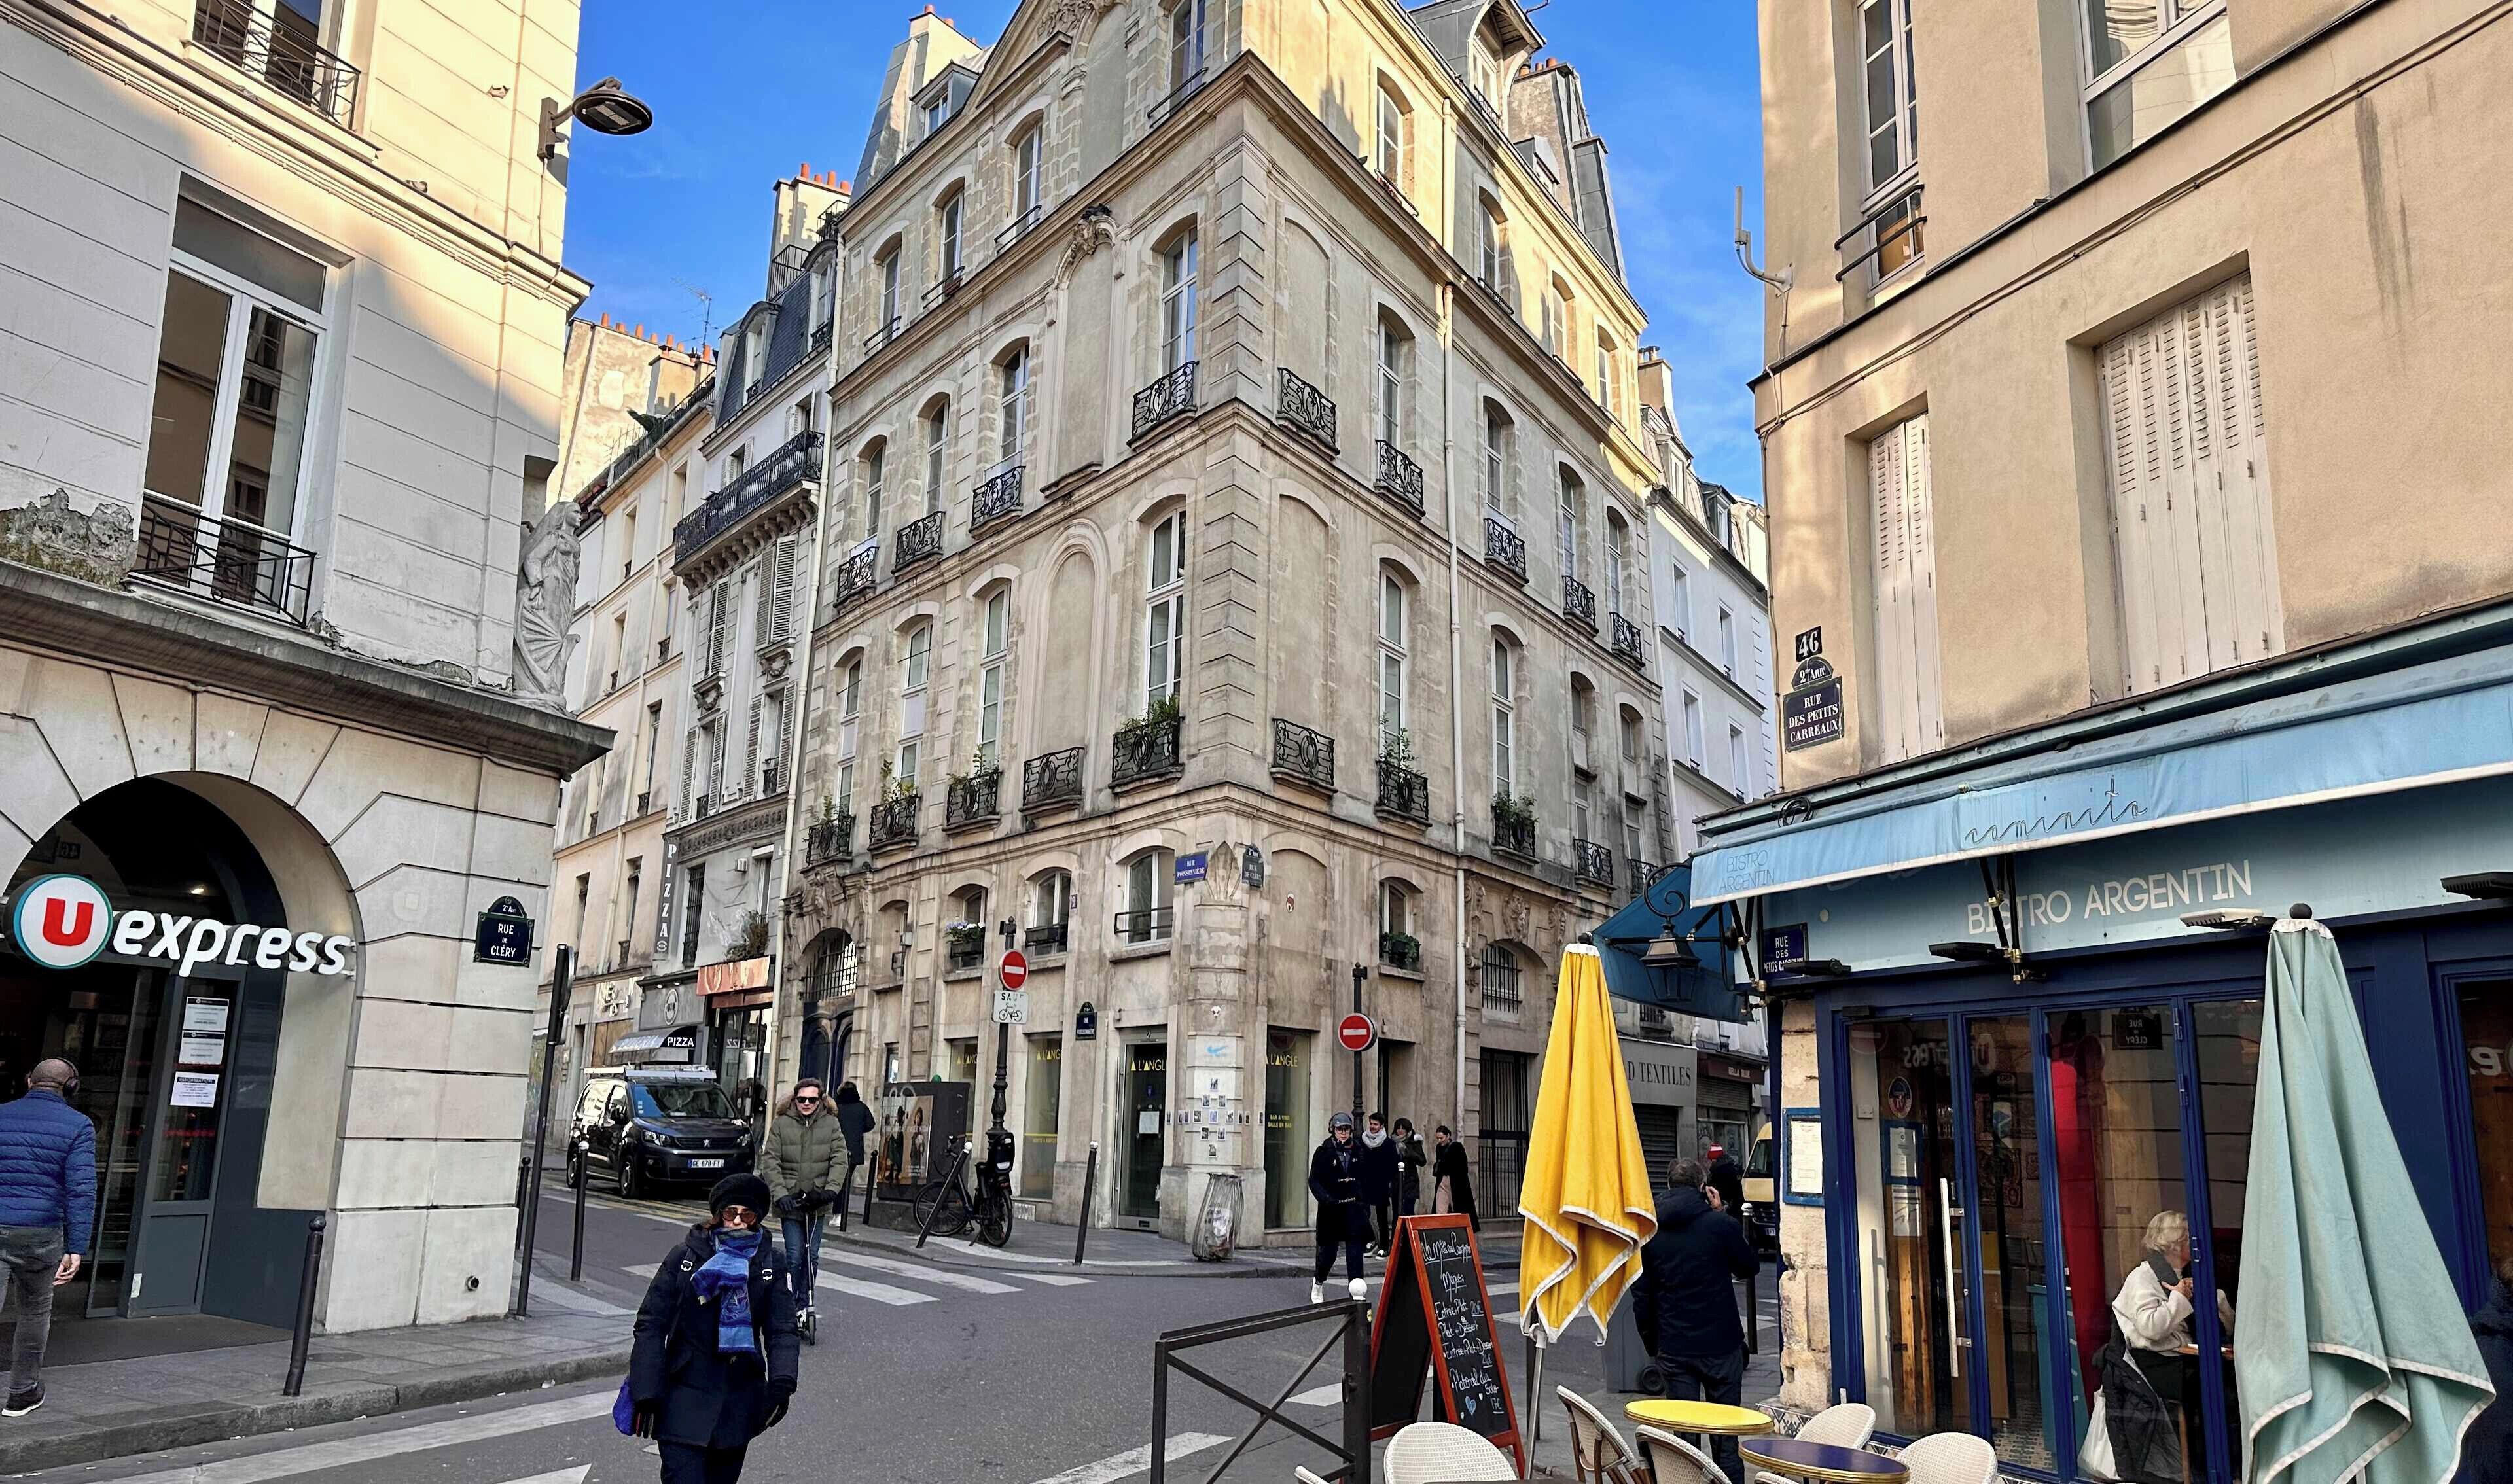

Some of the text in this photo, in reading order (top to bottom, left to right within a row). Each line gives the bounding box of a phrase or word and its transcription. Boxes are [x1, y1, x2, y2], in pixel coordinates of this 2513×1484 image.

[1800, 631, 1819, 657] 46
[1804, 694, 1822, 709] RUE
[1789, 703, 1838, 728] DES PETITS
[1790, 719, 1839, 743] CARREAUX
[1726, 850, 1768, 873] BISTRO
[1719, 869, 1775, 892] ARGENTIN
[659, 844, 677, 937] PIZZA
[1967, 859, 2252, 935] BISTRO ARGENTIN
[43, 898, 352, 977] U express
[497, 923, 514, 934] RUE
[491, 944, 516, 958] CLÉRY
[1775, 936, 1788, 948] RUE
[1775, 949, 1789, 959] DES
[667, 1036, 694, 1047] PIZZA
[1043, 1048, 1061, 1060] L'ANG
[1270, 1054, 1299, 1067] L'ANGLE
[1138, 1059, 1167, 1072] L'ANGL
[1639, 1062, 1691, 1086] TEXTILES
